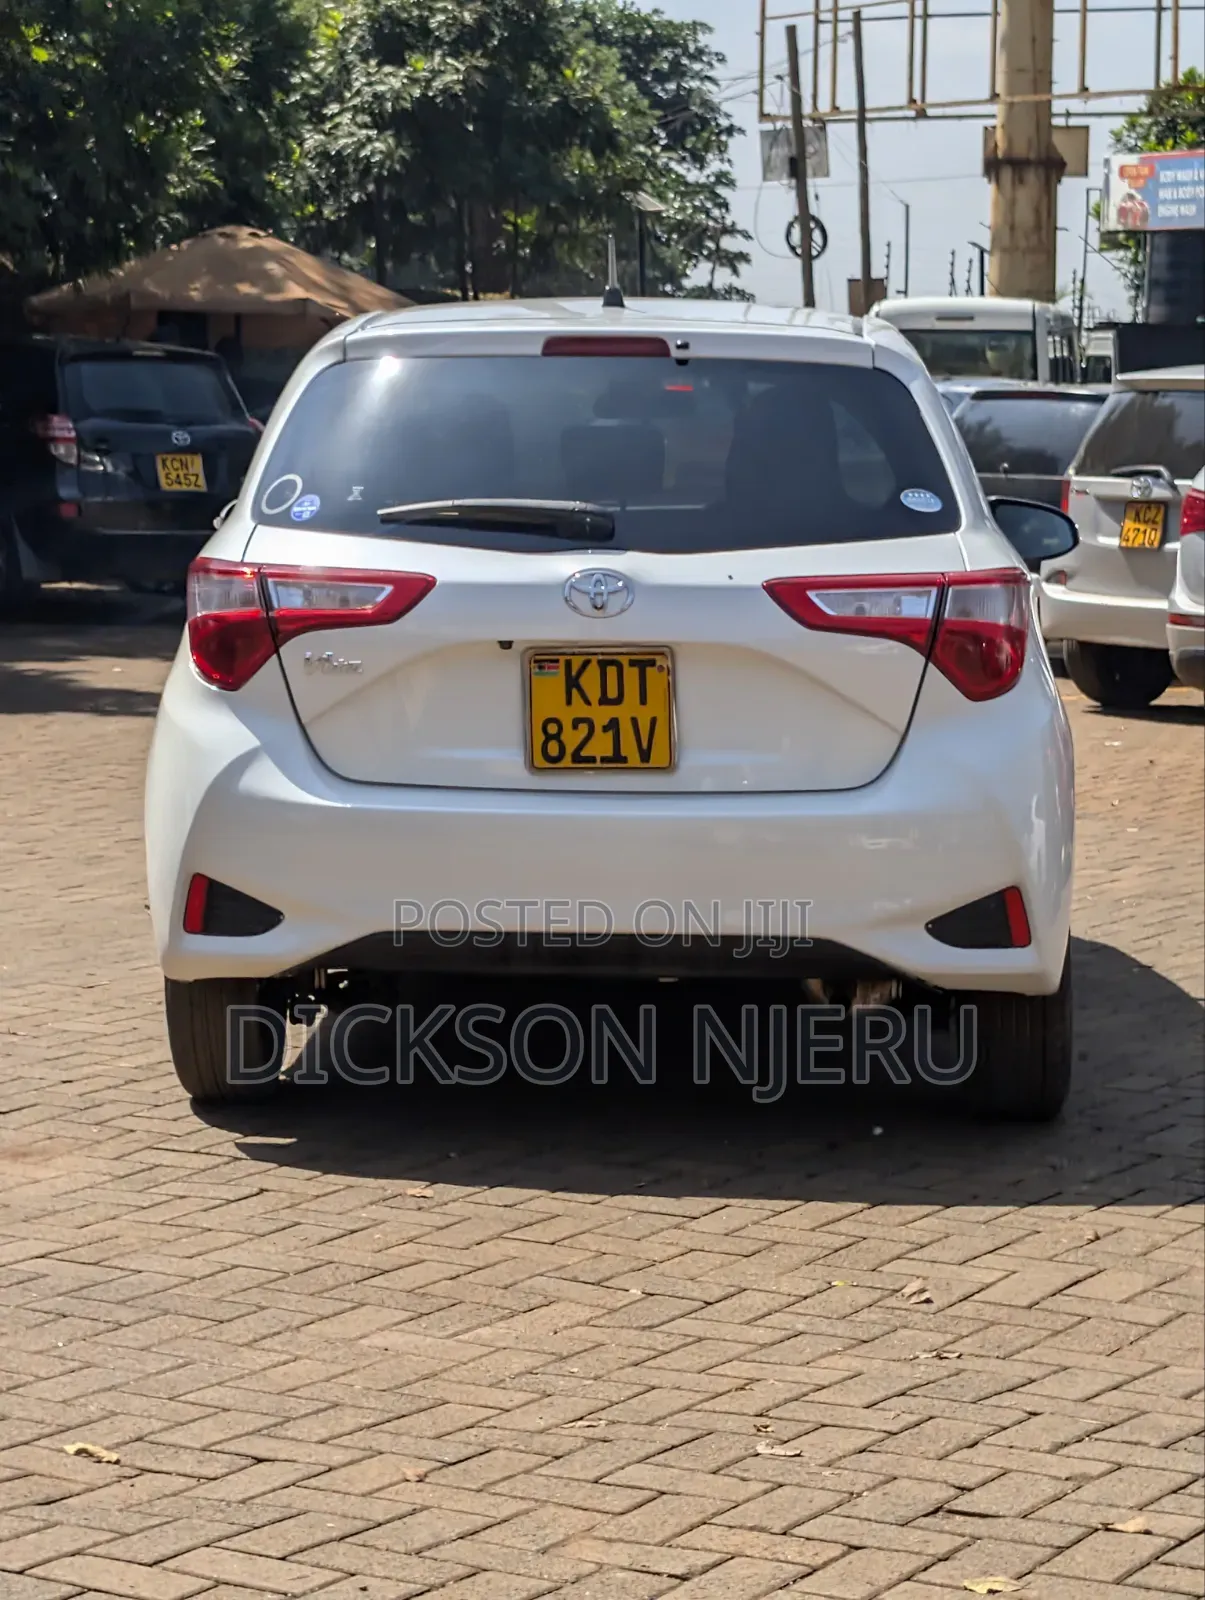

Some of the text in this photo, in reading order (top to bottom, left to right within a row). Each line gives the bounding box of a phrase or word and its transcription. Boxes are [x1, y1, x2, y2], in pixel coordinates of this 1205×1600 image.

[161, 456, 189, 472] KCN
[165, 473, 202, 488] 545Z
[1133, 505, 1161, 525] KCZ
[564, 658, 656, 707] KDT
[540, 716, 658, 765] 821V
